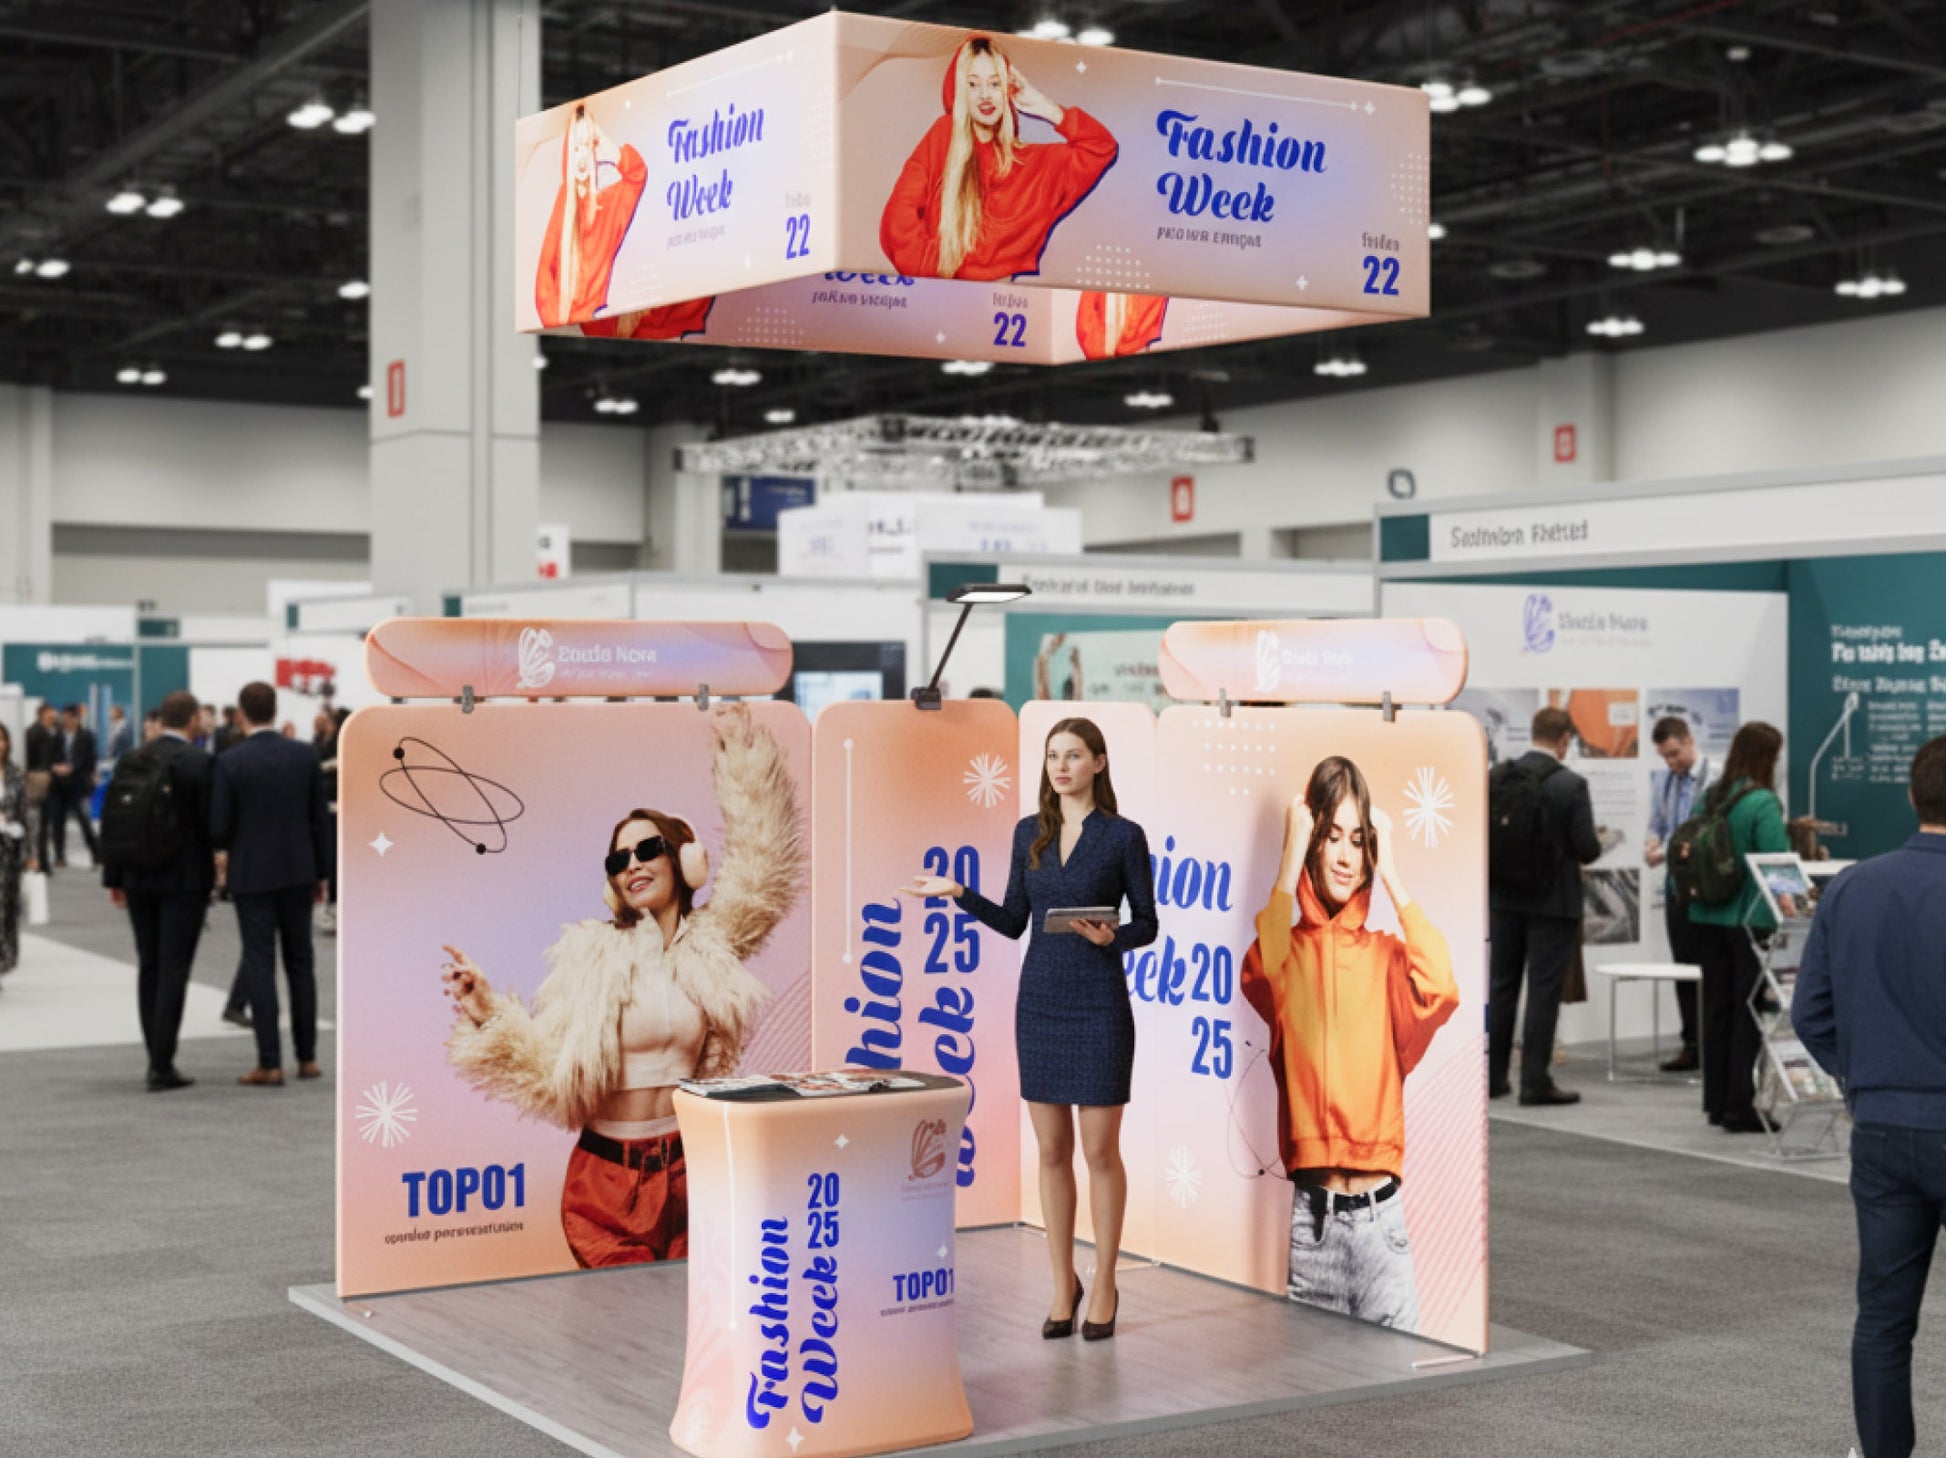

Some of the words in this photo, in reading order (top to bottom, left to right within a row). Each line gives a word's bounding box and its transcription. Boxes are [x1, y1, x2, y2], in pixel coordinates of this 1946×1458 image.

[667, 102, 765, 164] Fashion
[1156, 109, 1328, 174] Fashion
[666, 168, 734, 221] Week
[1156, 172, 1275, 223] Week
[785, 213, 811, 260] 22
[1363, 255, 1400, 296] 22
[993, 312, 1026, 347] 22
[923, 912, 980, 974] 25
[1191, 942, 1233, 1005] 20
[1191, 1015, 1233, 1079] 25
[402, 1162, 525, 1218] TOP01
[807, 1172, 840, 1208] 20
[807, 1211, 840, 1249] 25
[746, 1216, 790, 1429] Fashion
[800, 1255, 838, 1423] Week
